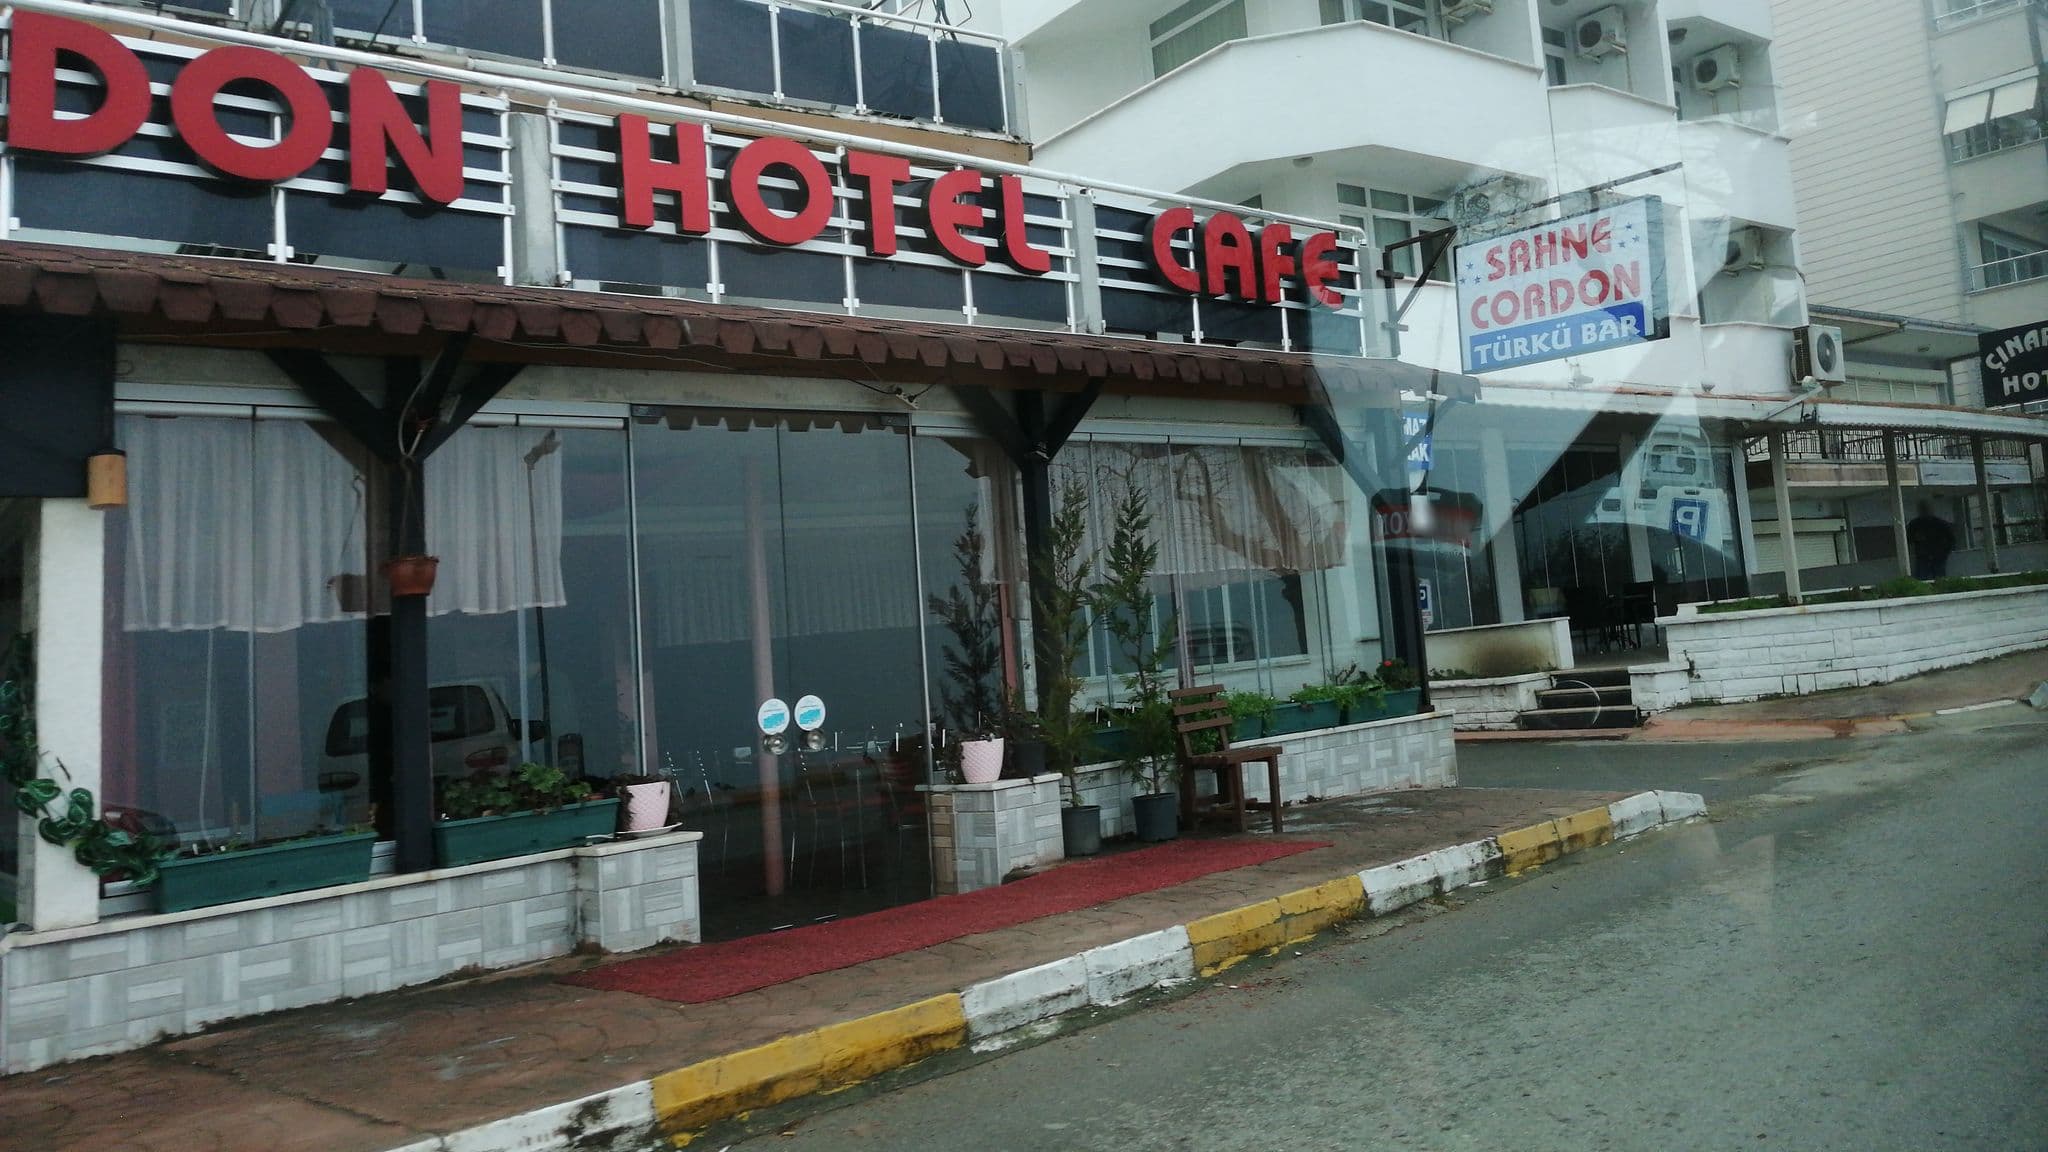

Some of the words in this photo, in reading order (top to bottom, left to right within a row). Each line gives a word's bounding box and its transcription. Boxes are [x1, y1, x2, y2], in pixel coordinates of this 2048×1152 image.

[7, 9, 464, 203] DON
[619, 113, 1050, 275] HOTEL
[1150, 206, 1342, 309] CAFE
[1487, 217, 1612, 282] SAHNE
[1470, 260, 1642, 329] CORDON
[1474, 322, 1572, 365] TÜRKÜ
[1582, 314, 1641, 345] BAR
